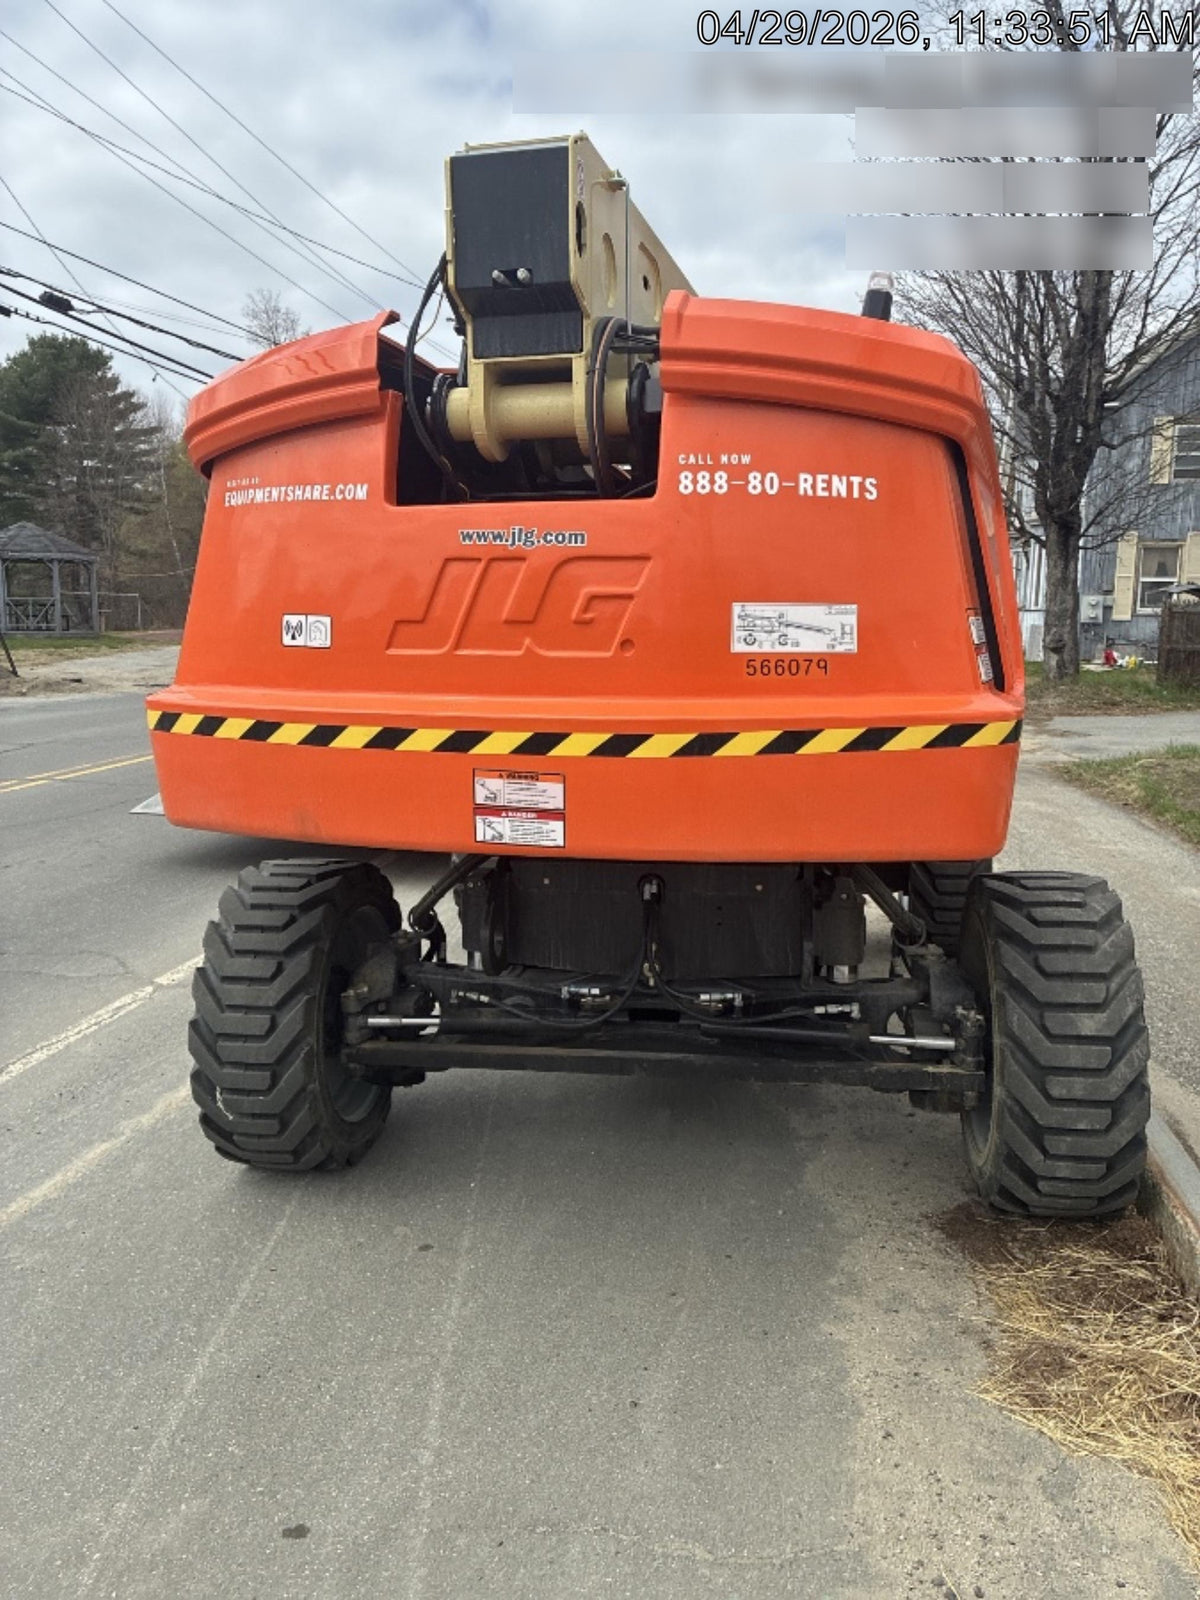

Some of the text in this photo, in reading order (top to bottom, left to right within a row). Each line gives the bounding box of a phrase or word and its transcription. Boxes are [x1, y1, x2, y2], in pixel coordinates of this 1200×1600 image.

[678, 454, 751, 465] CALL NOW
[224, 483, 369, 507] EQUIPMENTSHARE.COM
[678, 470, 878, 501] 888-80-RENTS
[459, 526, 587, 549] www.jlg.com
[746, 658, 828, 676] 566079
